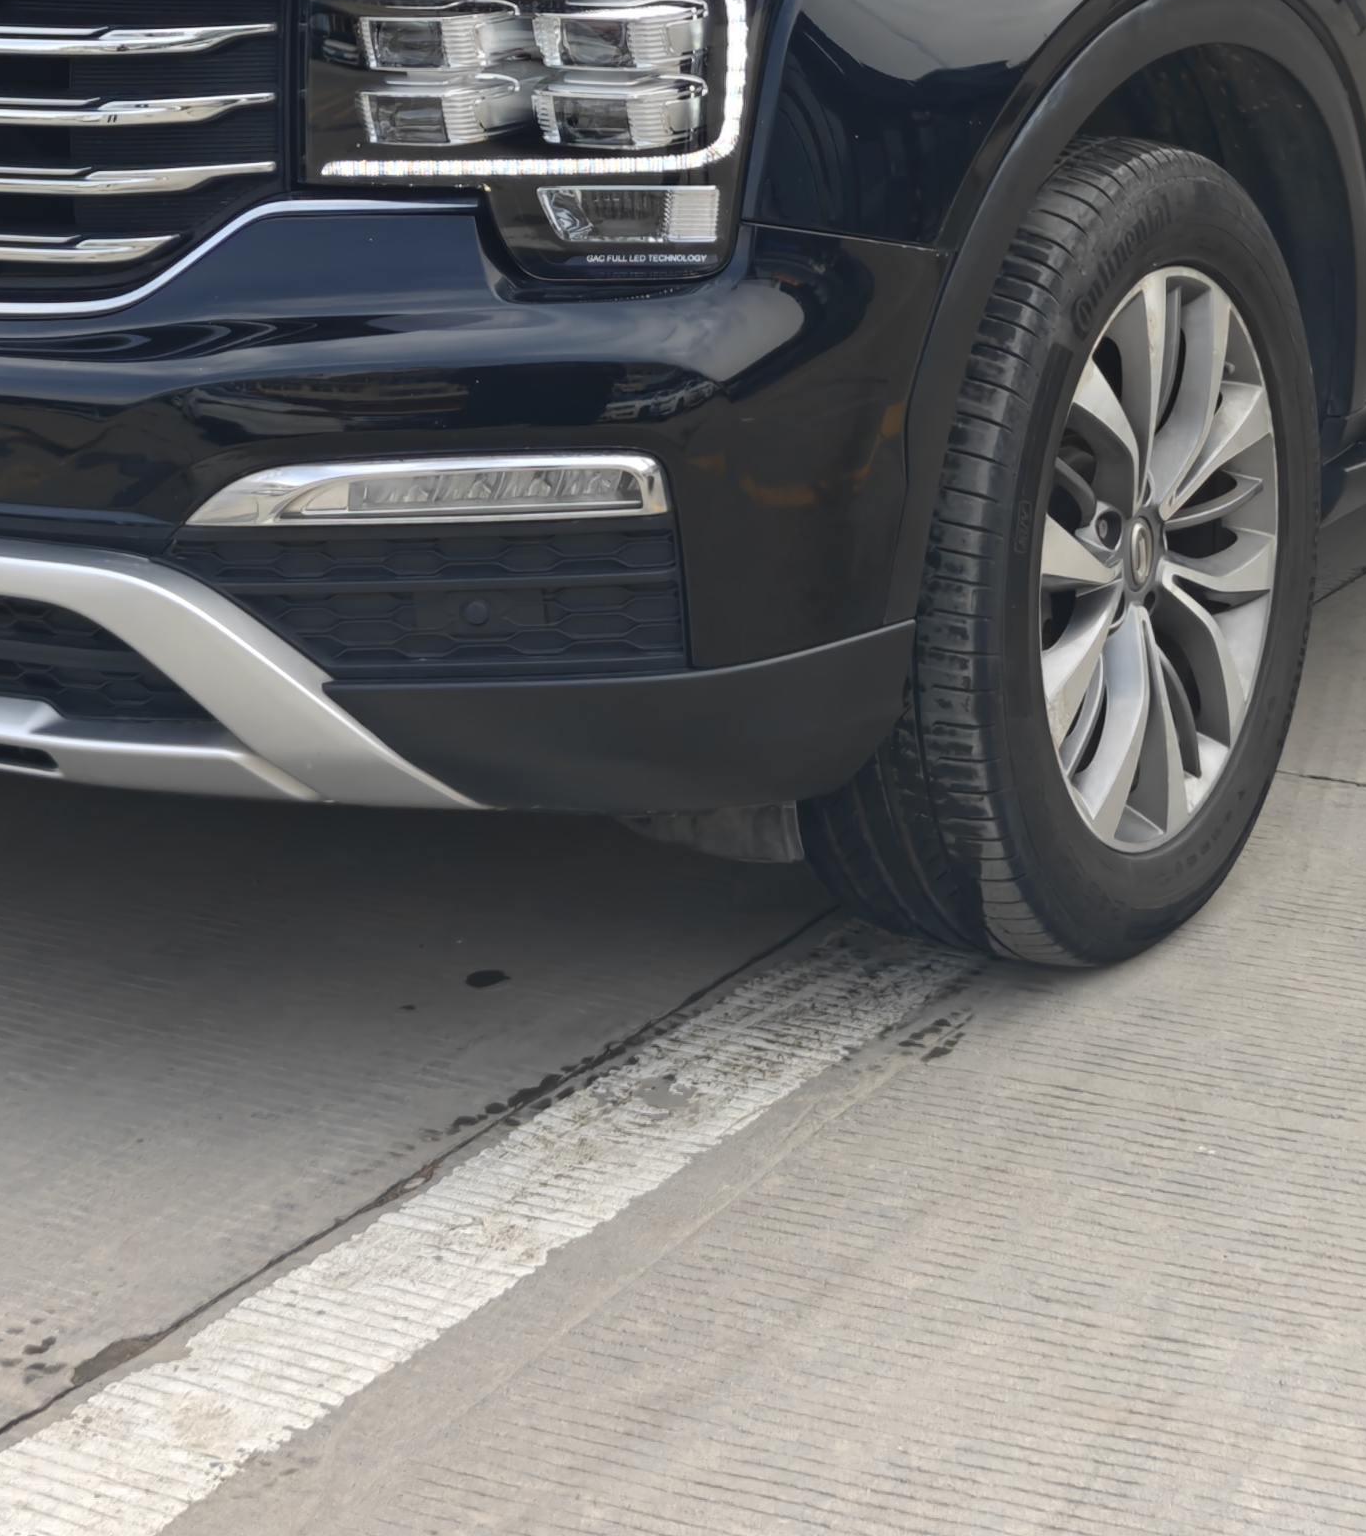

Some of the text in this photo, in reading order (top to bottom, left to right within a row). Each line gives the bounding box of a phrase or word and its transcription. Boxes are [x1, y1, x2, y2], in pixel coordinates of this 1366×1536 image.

[586, 253, 708, 263] GAC FULL LED TECHNOLOGY
